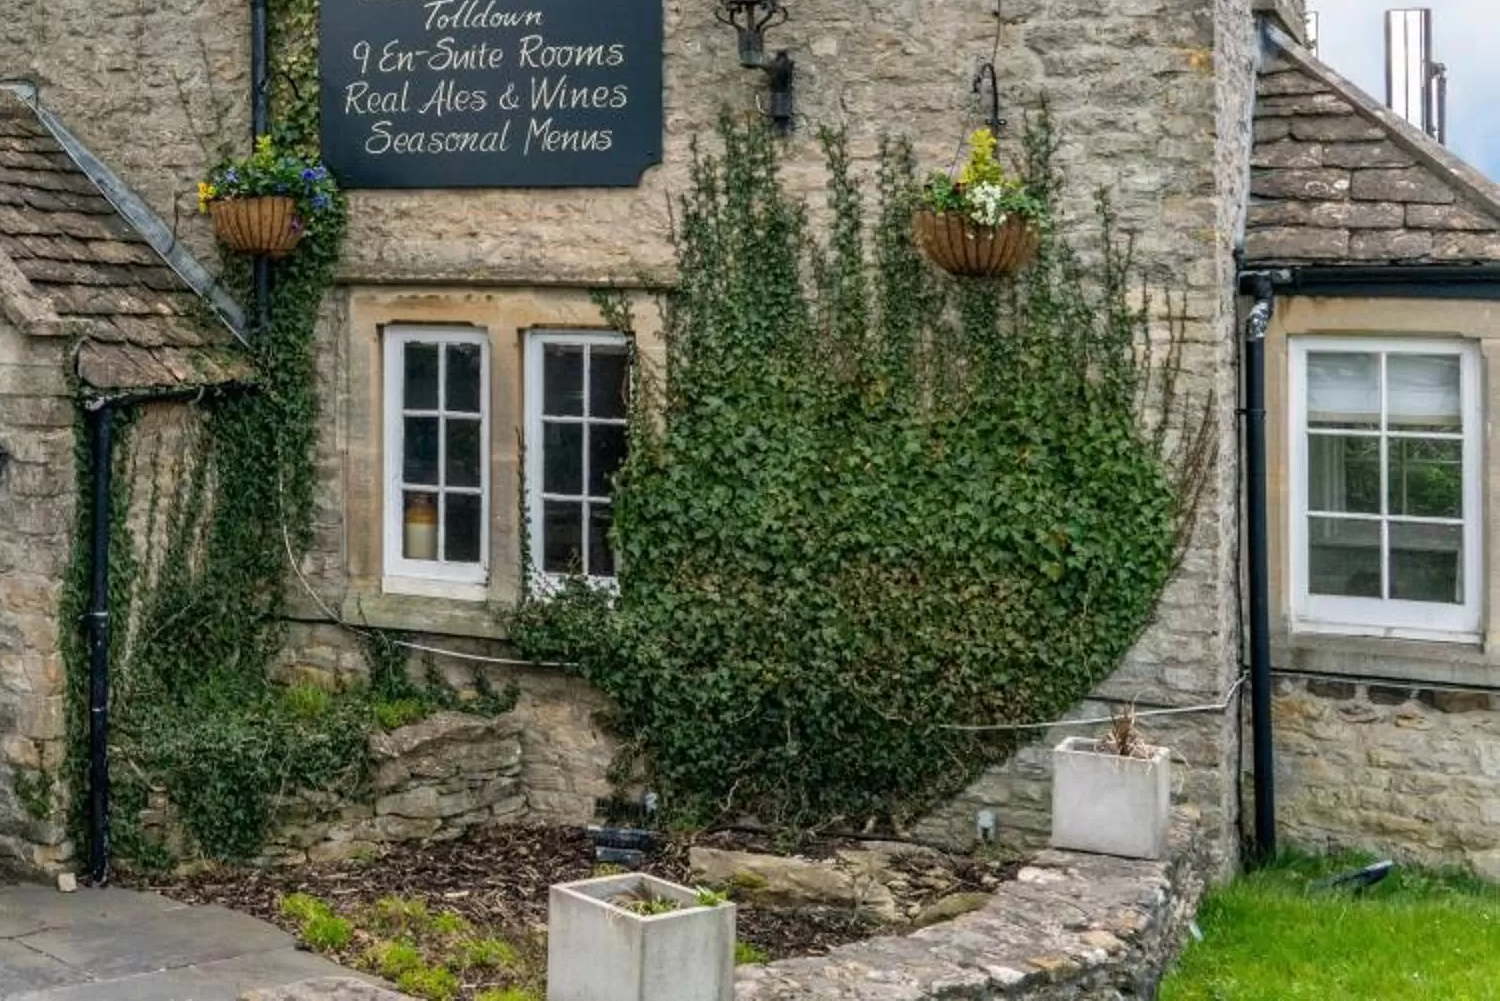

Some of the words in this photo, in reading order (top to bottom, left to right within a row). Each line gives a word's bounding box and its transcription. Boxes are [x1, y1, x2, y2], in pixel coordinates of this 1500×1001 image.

[352, 41, 371, 74] 9
[379, 37, 504, 73] En-Suite
[519, 34, 625, 68] Rooms
[345, 81, 409, 115] Real
[419, 79, 487, 117] Ales
[499, 82, 520, 111] &
[531, 74, 628, 111] Wines
[365, 120, 512, 155] Seasonal
[524, 118, 613, 157] Menus
